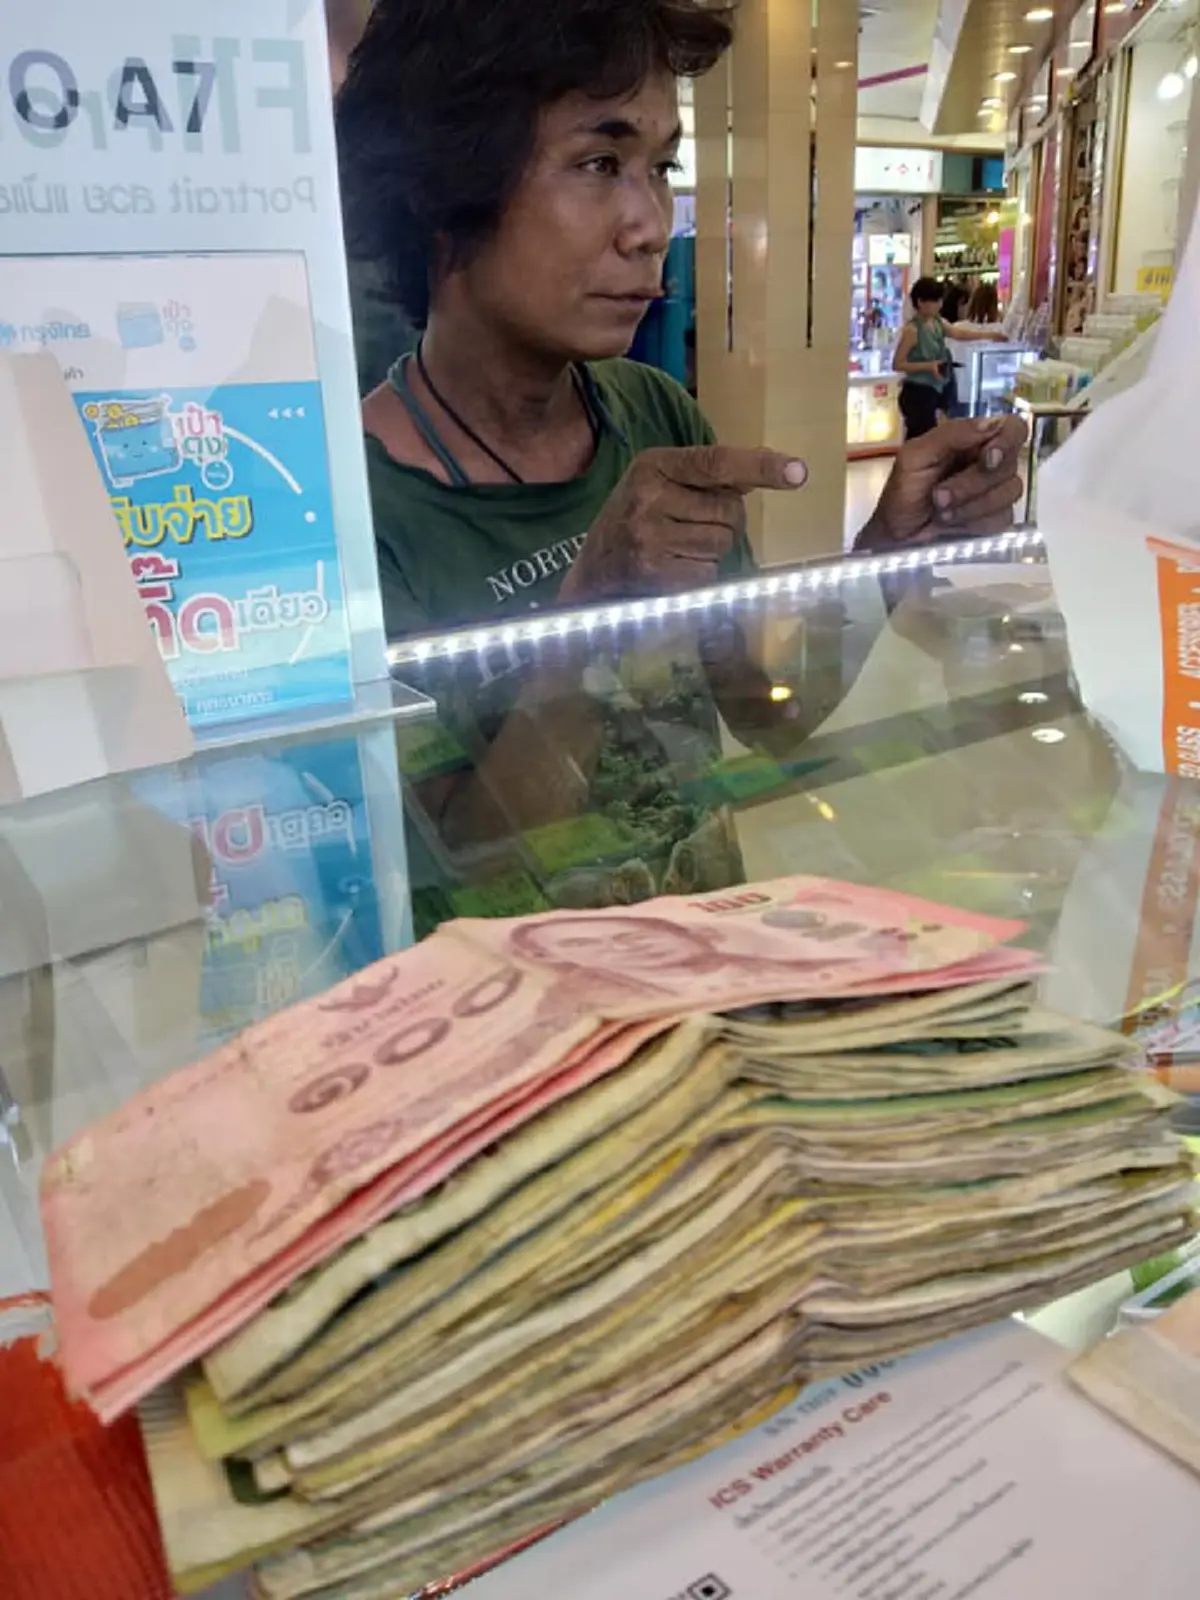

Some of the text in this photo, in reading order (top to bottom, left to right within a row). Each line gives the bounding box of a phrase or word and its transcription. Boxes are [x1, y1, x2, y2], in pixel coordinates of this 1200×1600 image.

[708, 1478, 753, 1510] ICS
[751, 1419, 844, 1481] Warranty
[842, 1390, 892, 1423] Care
